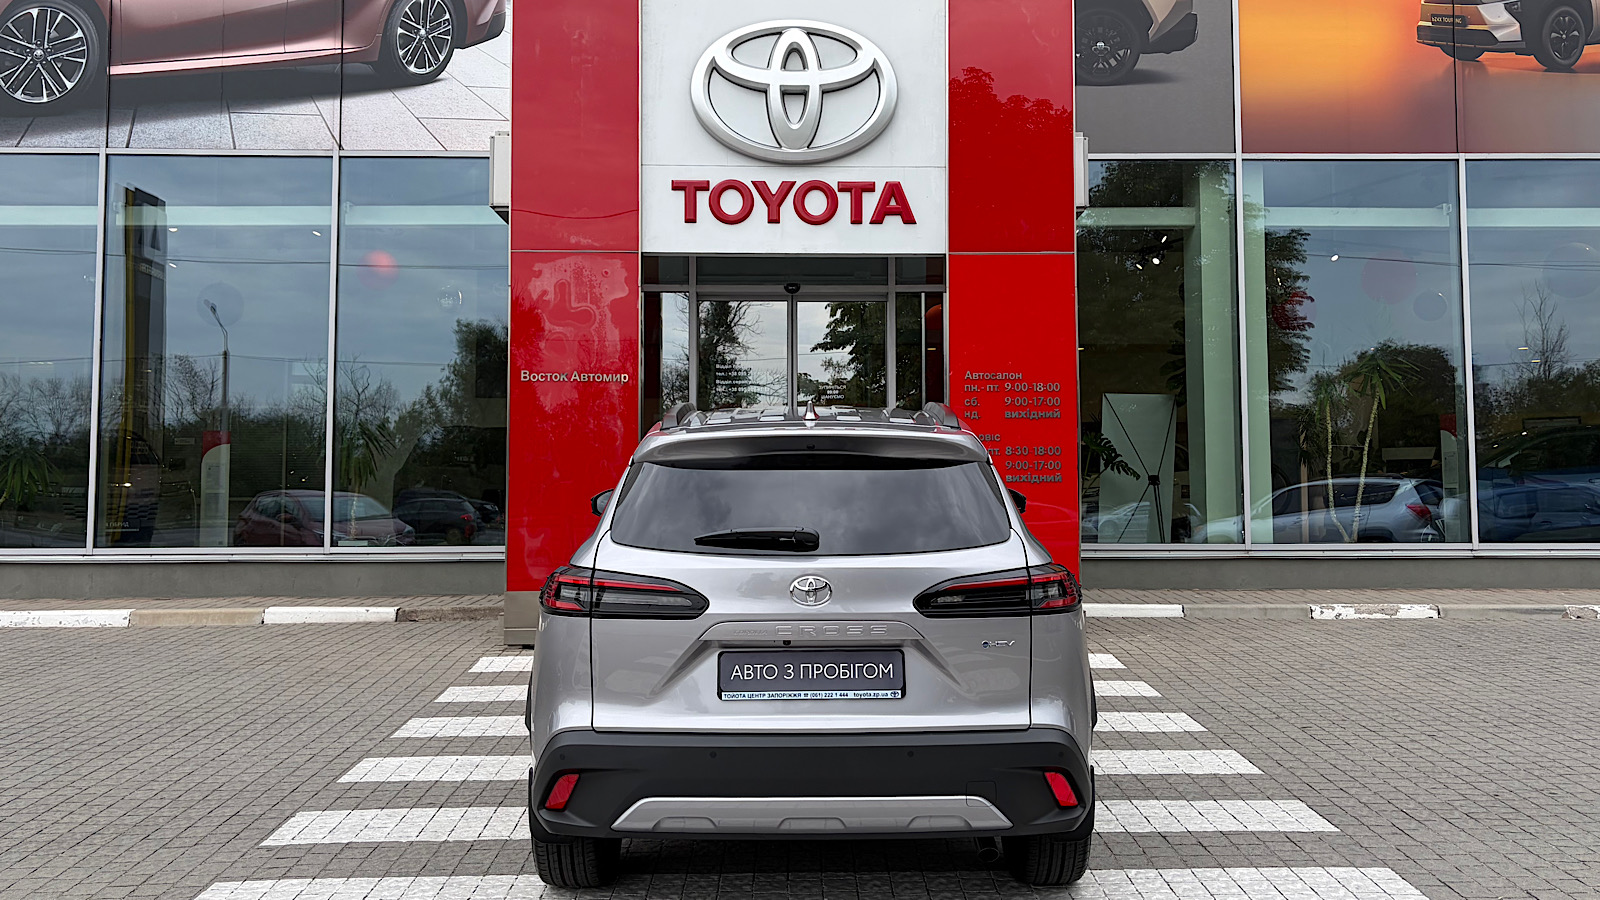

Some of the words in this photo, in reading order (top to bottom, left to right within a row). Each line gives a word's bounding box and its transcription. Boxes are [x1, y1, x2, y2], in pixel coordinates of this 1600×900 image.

[1443, 16, 1462, 24] TOURNG
[671, 179, 917, 225] TOYOTA
[520, 370, 568, 382] Восток
[570, 370, 629, 383] Автомир
[964, 371, 1023, 380] Автосалон
[964, 397, 980, 406] сб.
[1004, 396, 1061, 406] 9:00-17:00
[964, 410, 981, 420] нд.
[1004, 408, 1061, 420] вихідний
[1005, 460, 1062, 470] 9:00-17:00
[1005, 472, 1063, 484] вихідний
[775, 625, 888, 637] CROSS
[730, 664, 778, 680] АВТО
[800, 663, 894, 679] ПРОБІГОМ
[853, 691, 889, 699] toyota.zp.ua
